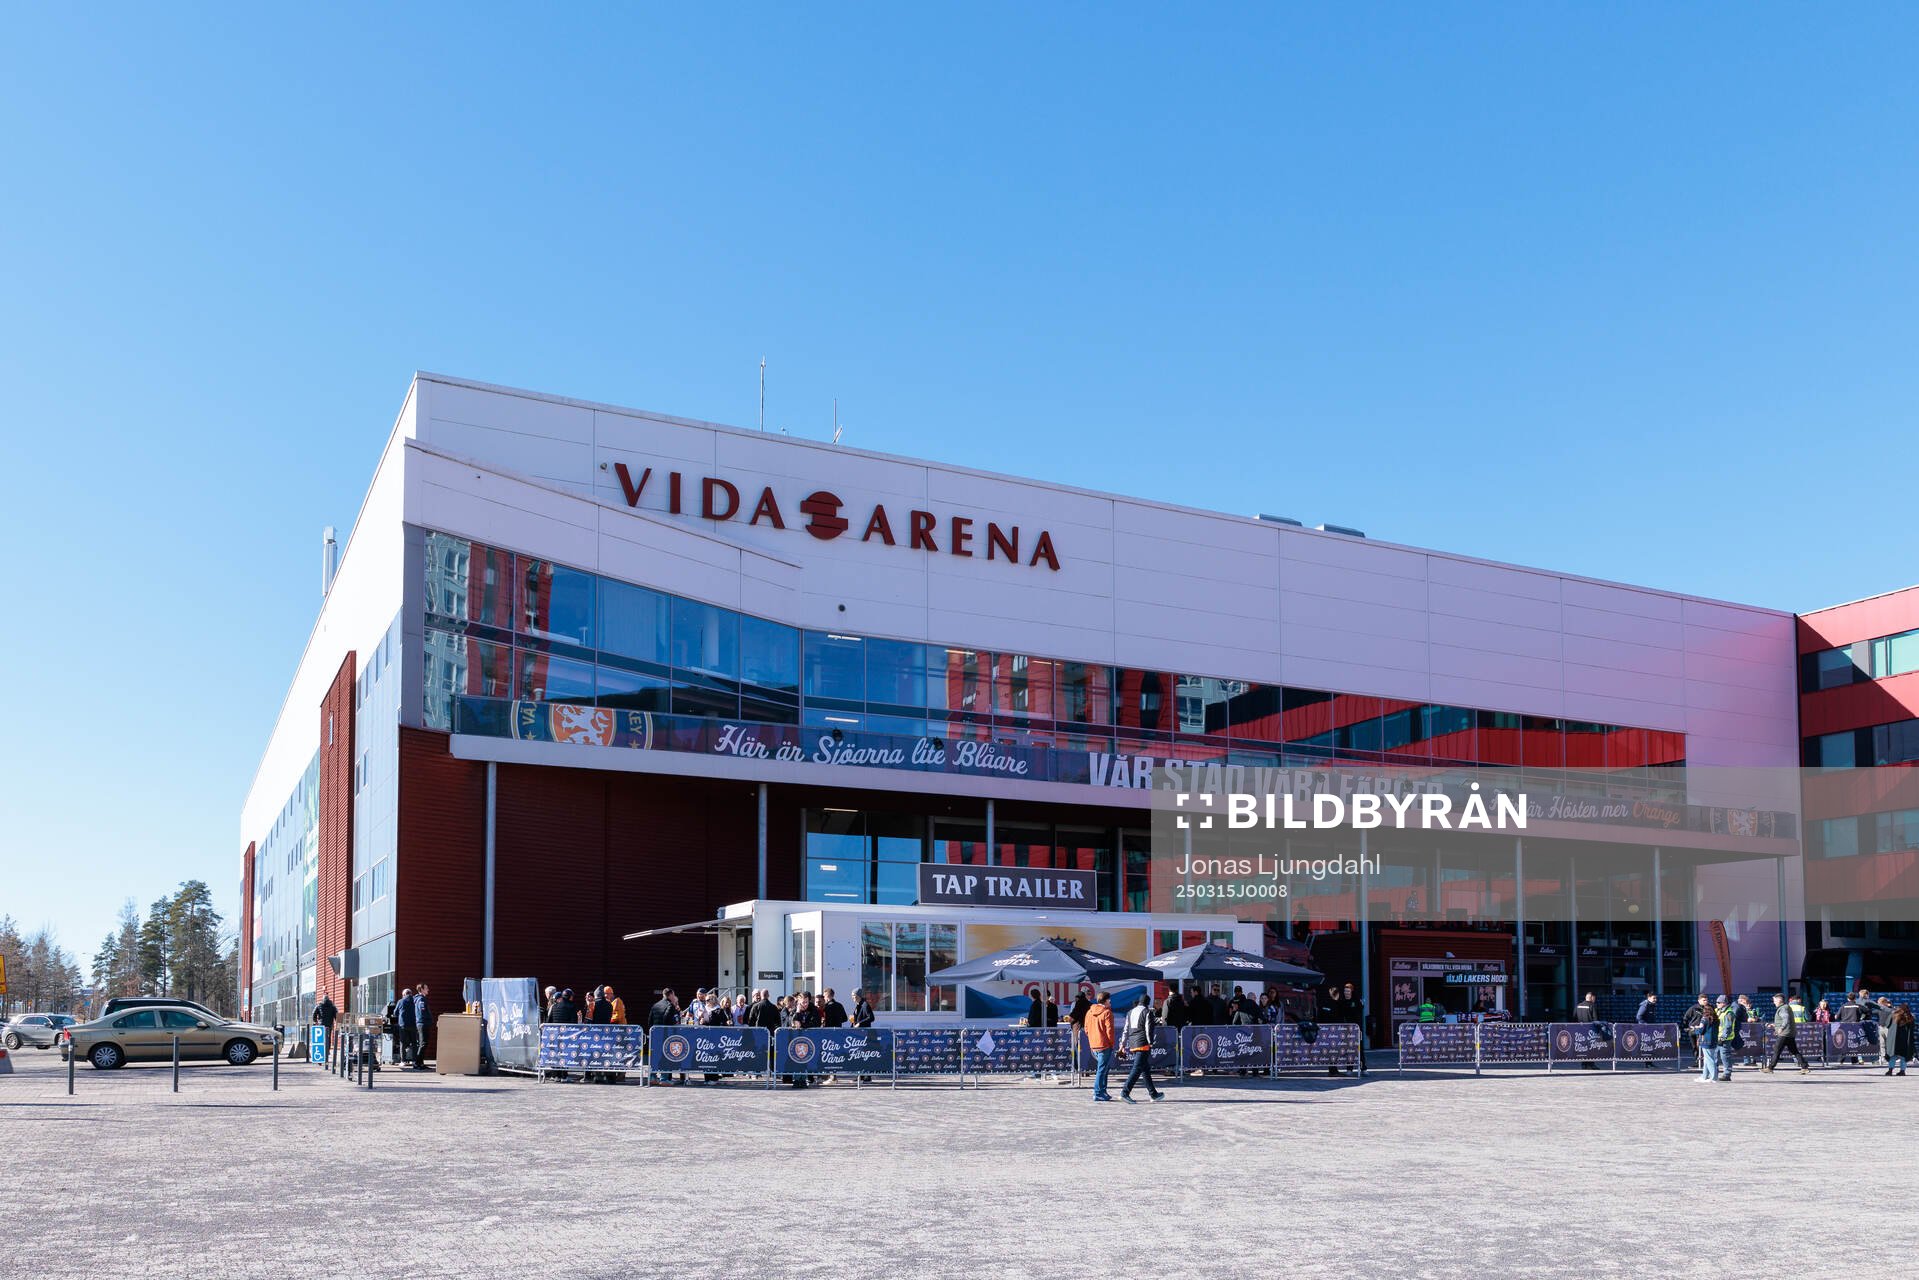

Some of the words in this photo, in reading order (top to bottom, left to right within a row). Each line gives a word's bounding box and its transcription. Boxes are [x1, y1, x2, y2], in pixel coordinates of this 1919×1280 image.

[614, 462, 784, 530] VIDA
[862, 504, 1060, 571] ARENA
[714, 724, 769, 759] Här
[776, 742, 805, 762] är
[813, 736, 904, 765] Sjöarna
[912, 738, 946, 764] lite
[952, 741, 1028, 774] Blåare
[1090, 752, 1153, 789] VÅR
[1163, 758, 1245, 796] STAD
[1548, 796, 1599, 819] Hösten
[1602, 803, 1628, 818] mer
[932, 874, 977, 895] TAP
[985, 876, 1084, 899] TRAILER
[1464, 974, 1490, 983] LAKERS
[314, 1027, 323, 1042] P
[1217, 1036, 1232, 1046] Vår
[1234, 1032, 1254, 1044] Stad
[696, 1038, 715, 1050] Vår
[718, 1036, 743, 1048] Stad
[821, 1039, 840, 1051] Vår
[843, 1036, 868, 1049] Stad
[696, 1050, 719, 1062] Våra
[722, 1047, 755, 1061] Färger
[821, 1051, 845, 1063] Våra
[848, 1048, 881, 1061] Färger
[1216, 1047, 1236, 1059] Våra
[1237, 1043, 1262, 1056] Färger
